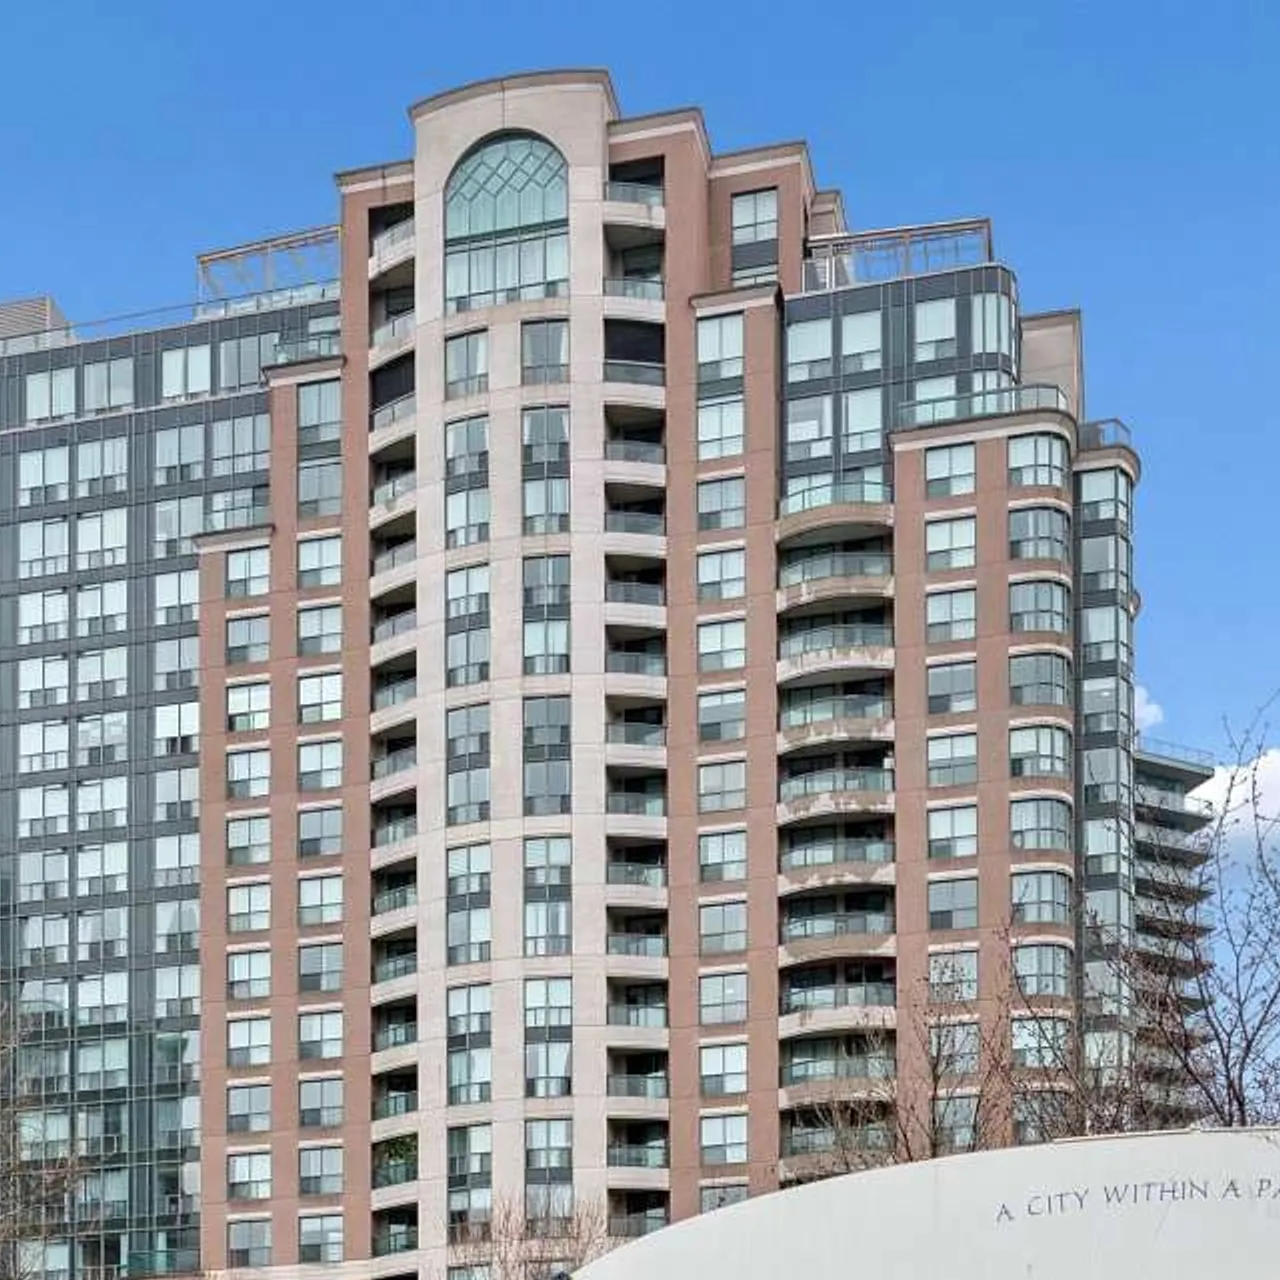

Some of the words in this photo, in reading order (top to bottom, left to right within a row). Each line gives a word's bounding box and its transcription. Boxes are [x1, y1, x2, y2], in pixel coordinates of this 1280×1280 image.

[996, 1203, 1015, 1223] A
[1027, 1189, 1089, 1216] CITY
[1103, 1180, 1208, 1204] WITHIN
[1222, 1179, 1241, 1199] A
